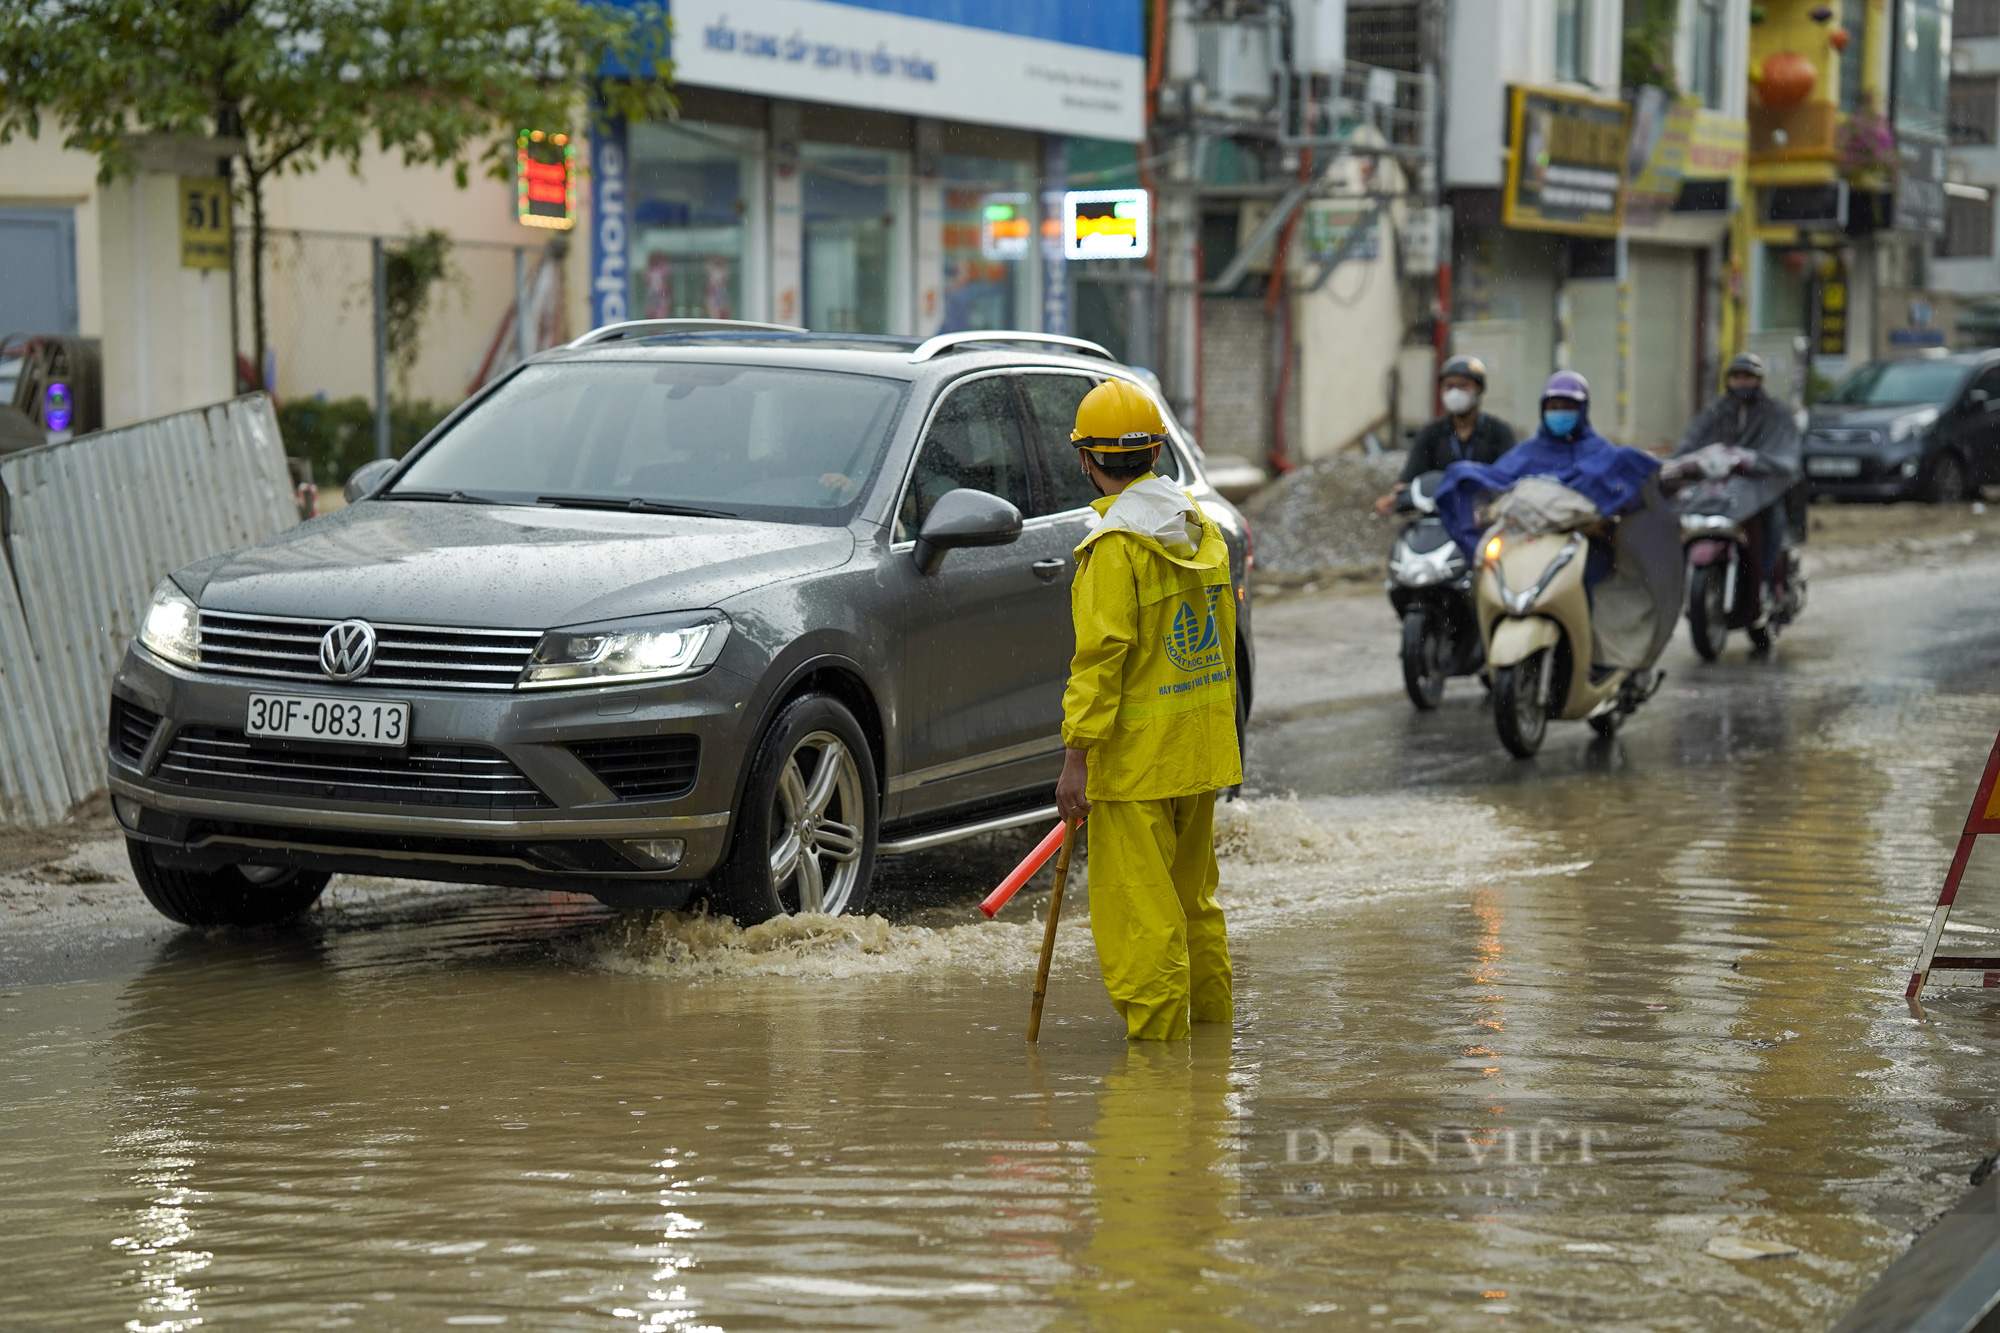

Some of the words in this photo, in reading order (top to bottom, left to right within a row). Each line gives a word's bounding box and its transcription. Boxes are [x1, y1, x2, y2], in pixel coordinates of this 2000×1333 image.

[186, 191, 220, 230] 51
[1166, 634, 1187, 666] THOÁT
[251, 698, 402, 739] 30F-083.13
